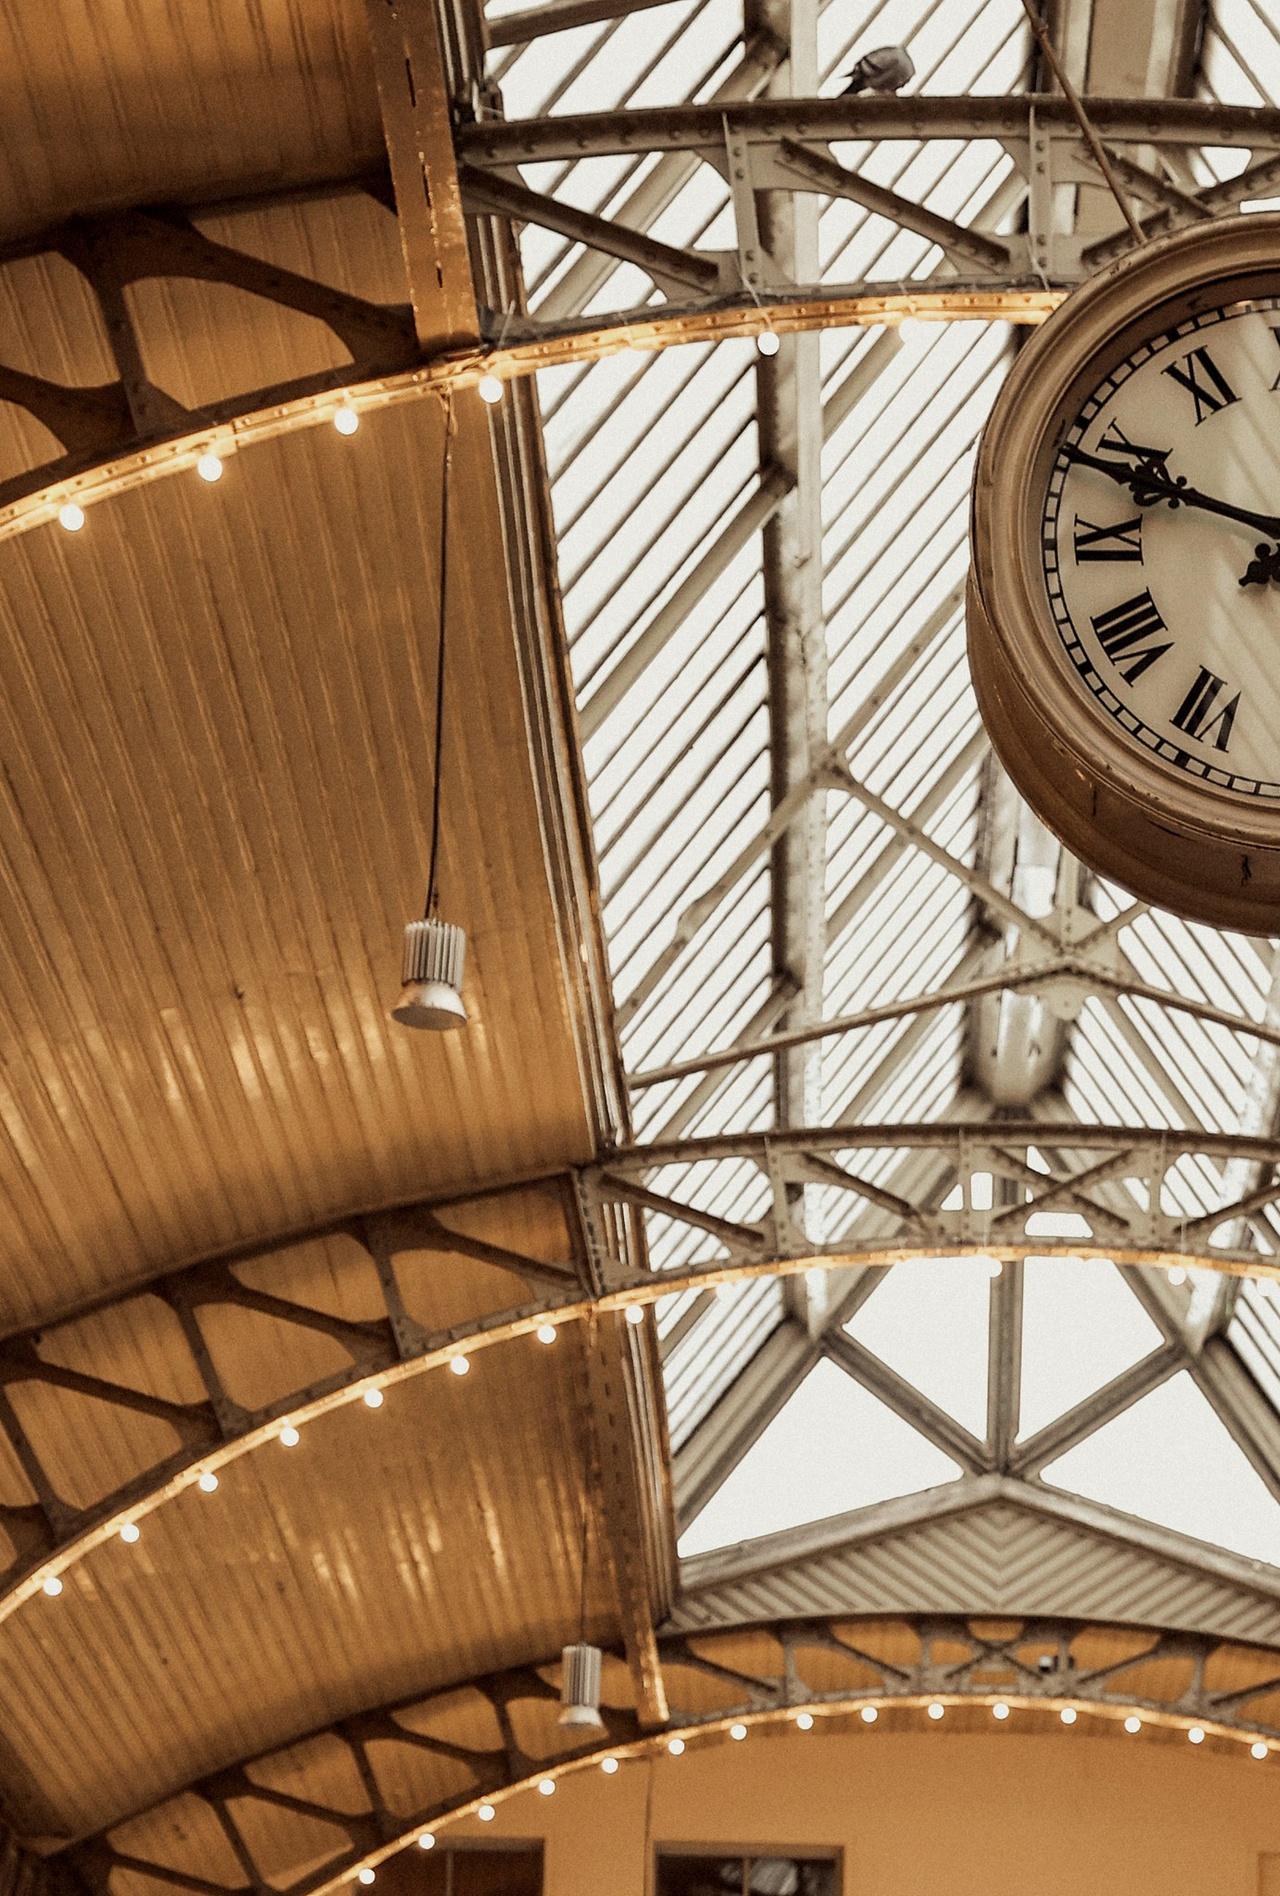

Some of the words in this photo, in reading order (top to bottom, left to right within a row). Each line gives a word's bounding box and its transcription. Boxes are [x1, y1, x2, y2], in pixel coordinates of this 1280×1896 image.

[1160, 344, 1243, 427] XI
[1074, 513, 1144, 566] IX
[1089, 586, 1175, 688] VIII
[1169, 664, 1242, 753] VII
